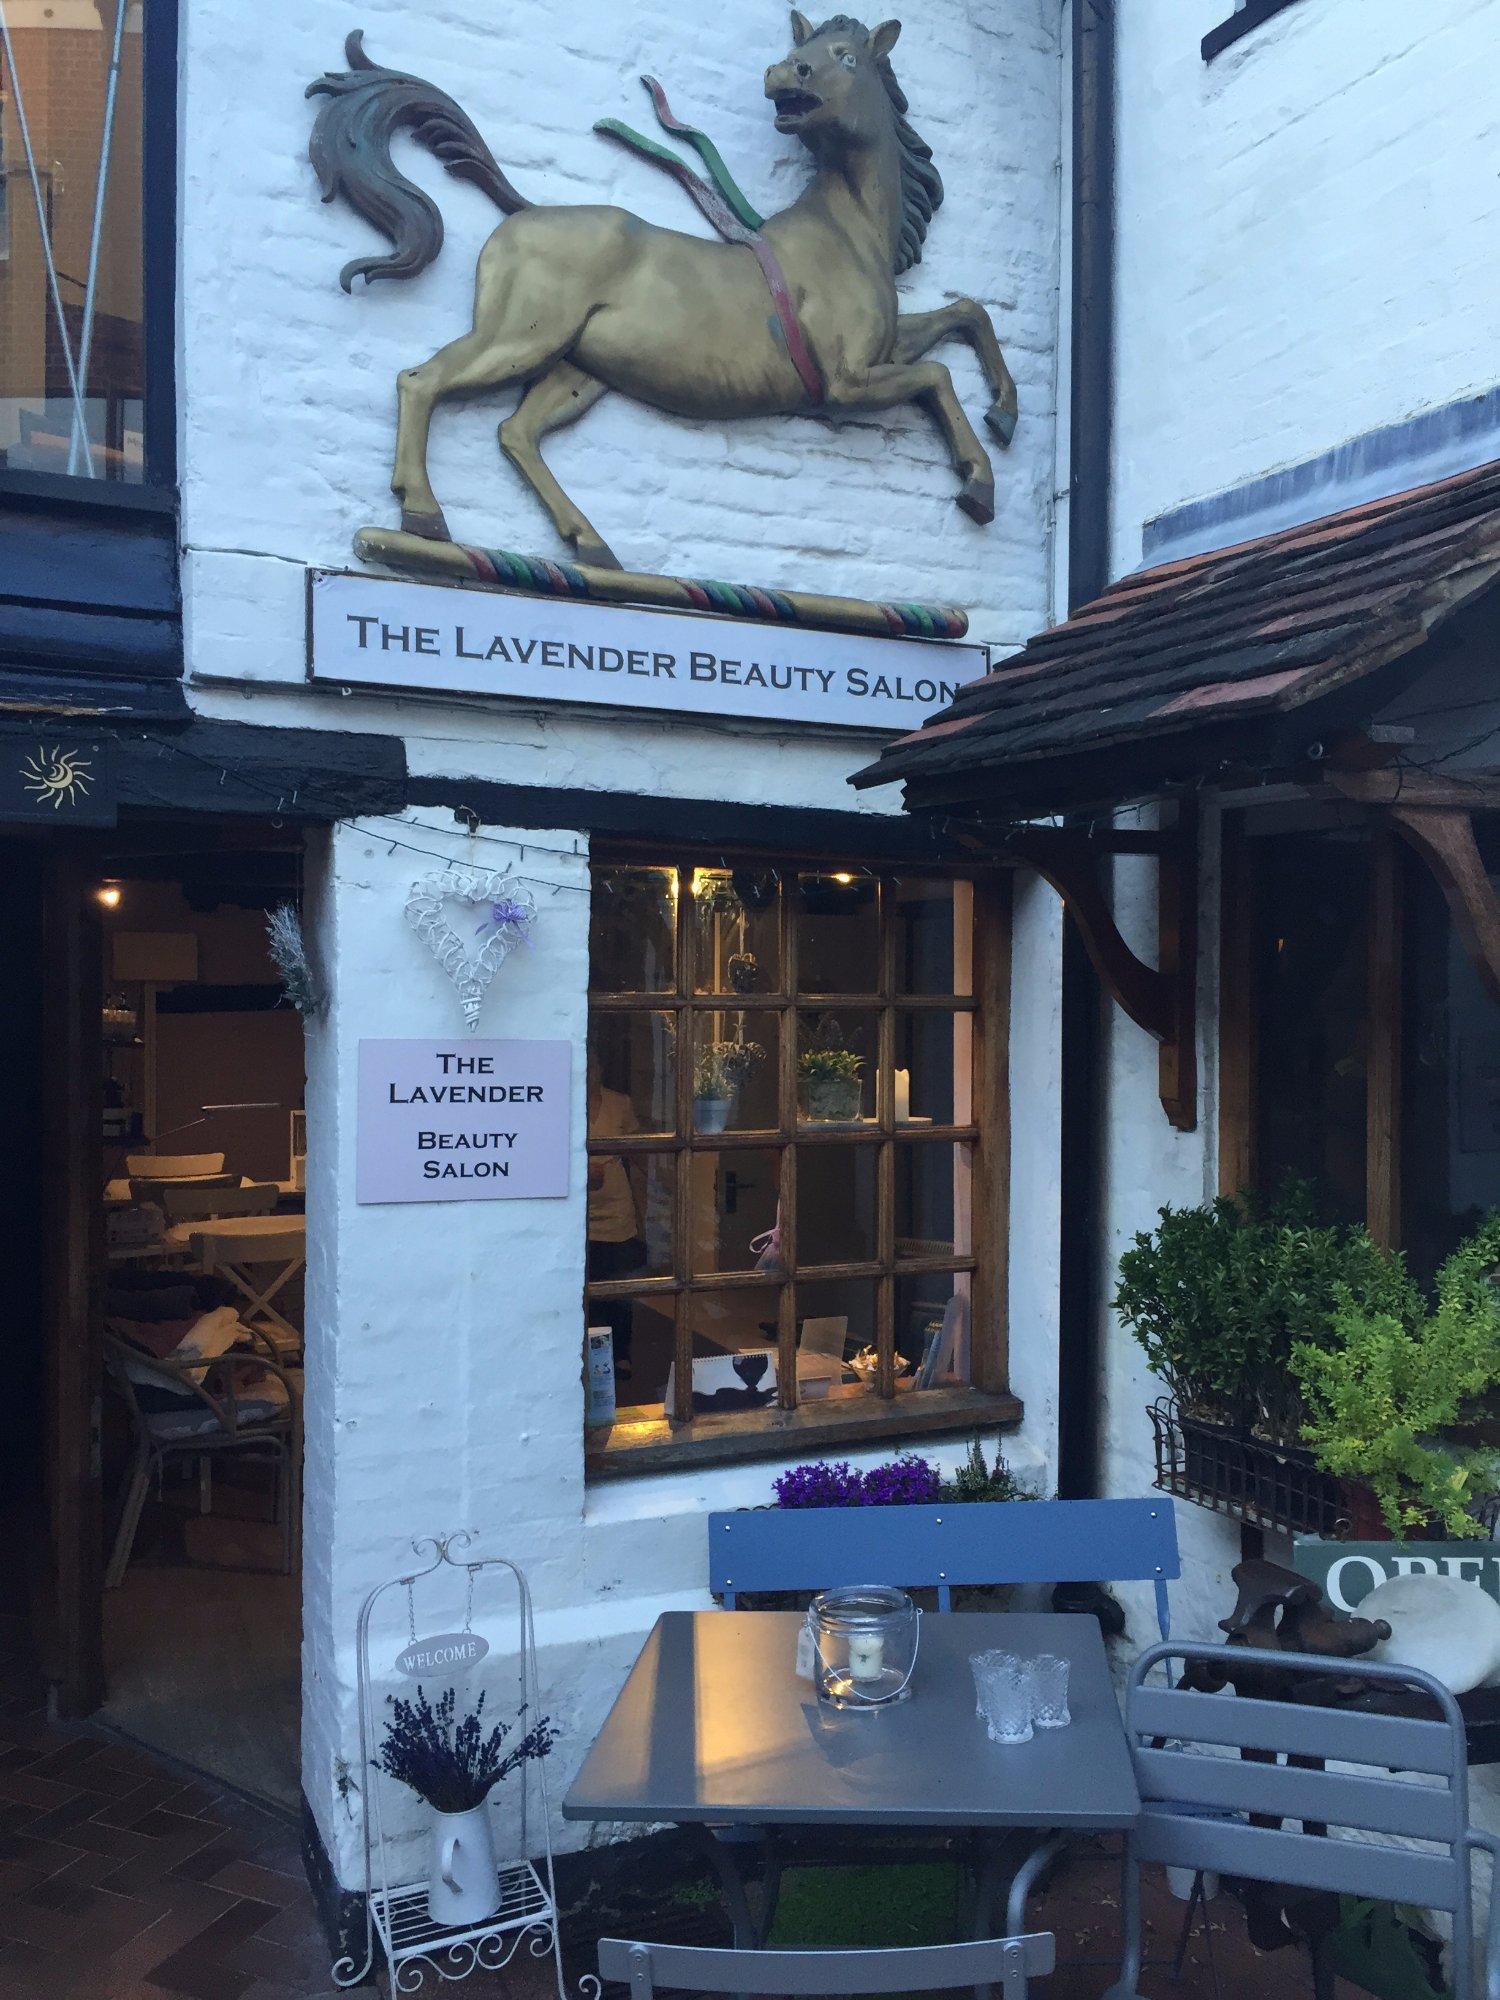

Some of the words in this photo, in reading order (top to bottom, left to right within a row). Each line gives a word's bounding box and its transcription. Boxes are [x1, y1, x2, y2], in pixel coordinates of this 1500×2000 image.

[347, 614, 440, 656] THE
[455, 626, 677, 680] LAVENDER
[690, 651, 836, 693] BEAUTY
[846, 667, 961, 704] SALON
[436, 1053, 494, 1074] THE
[389, 1083, 544, 1104] LAVENDER
[418, 1131, 519, 1150] BEAUTY
[423, 1160, 509, 1179] SALON
[403, 1642, 477, 1672] WELCOME
